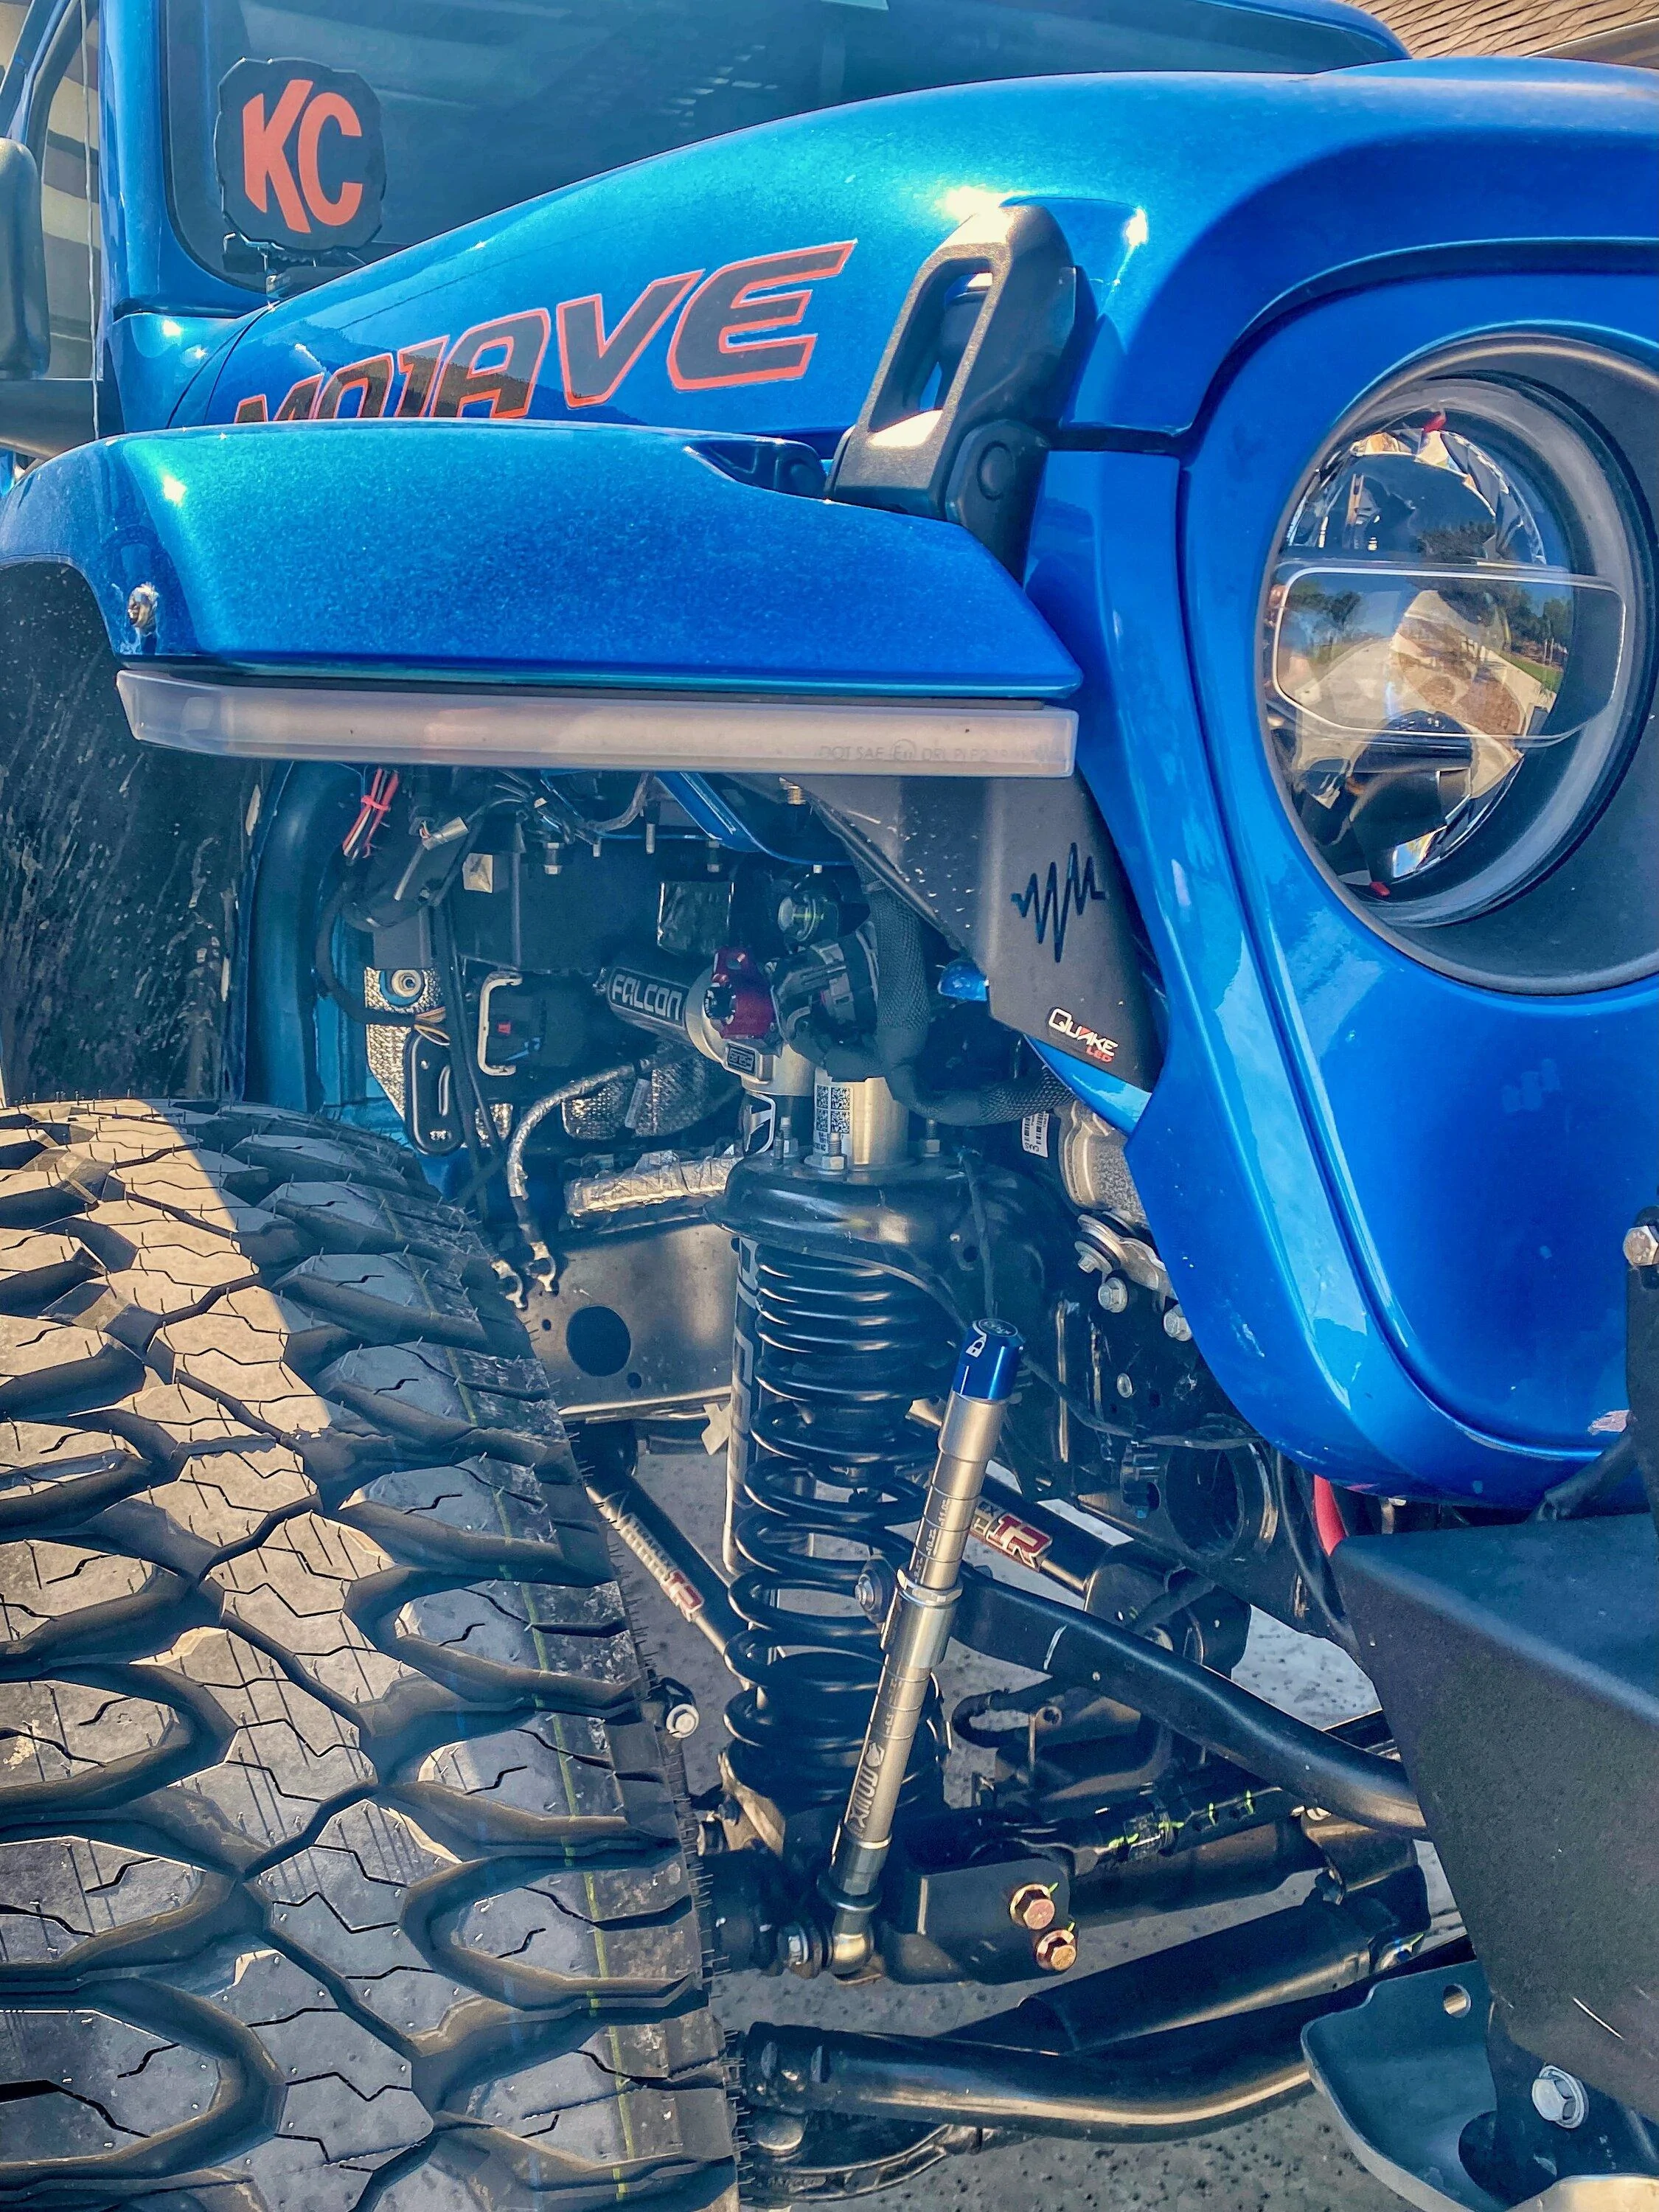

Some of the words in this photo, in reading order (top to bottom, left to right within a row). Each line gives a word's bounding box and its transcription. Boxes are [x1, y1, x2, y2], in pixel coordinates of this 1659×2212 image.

[243, 79, 362, 233] KC
[612, 974, 682, 1021] FALCON
[1048, 1008, 1119, 1056] QUAKE
[1086, 1046, 1113, 1062] LED
